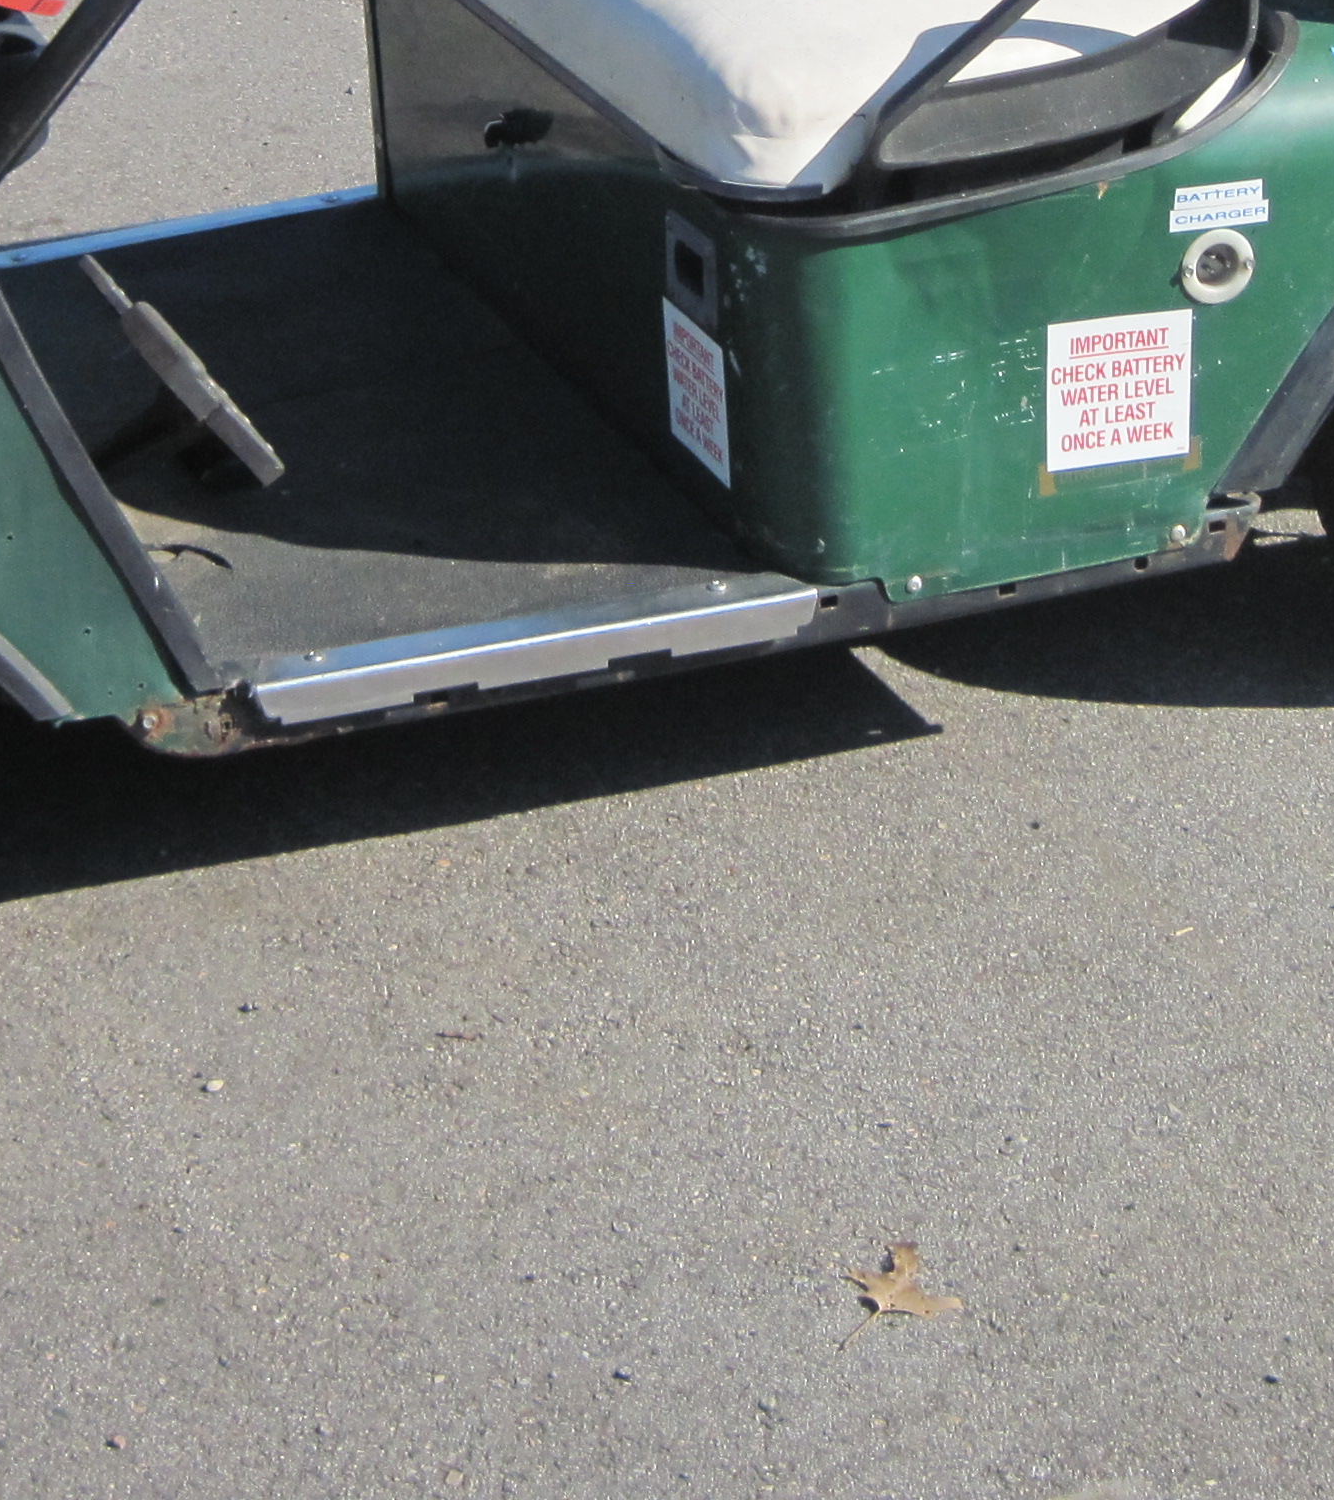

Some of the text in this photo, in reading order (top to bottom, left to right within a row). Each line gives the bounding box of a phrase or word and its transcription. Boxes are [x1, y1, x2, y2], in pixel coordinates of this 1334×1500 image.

[1176, 185, 1261, 204] BATTERY
[1175, 206, 1267, 225] CHARGER
[1070, 327, 1169, 355] IMPORTANT
[667, 339, 724, 403] CHECK BATTERY
[1051, 353, 1186, 386] CHECK BATTERY
[673, 366, 721, 423] WATER LEVEL
[1060, 377, 1174, 407] WATER LEVEL
[692, 401, 714, 435] LEAST
[1079, 401, 1156, 427] AT LEAST
[675, 408, 695, 436] ONCE
[703, 437, 723, 464] WEEK
[1061, 422, 1174, 452] ONCE A WEEK
